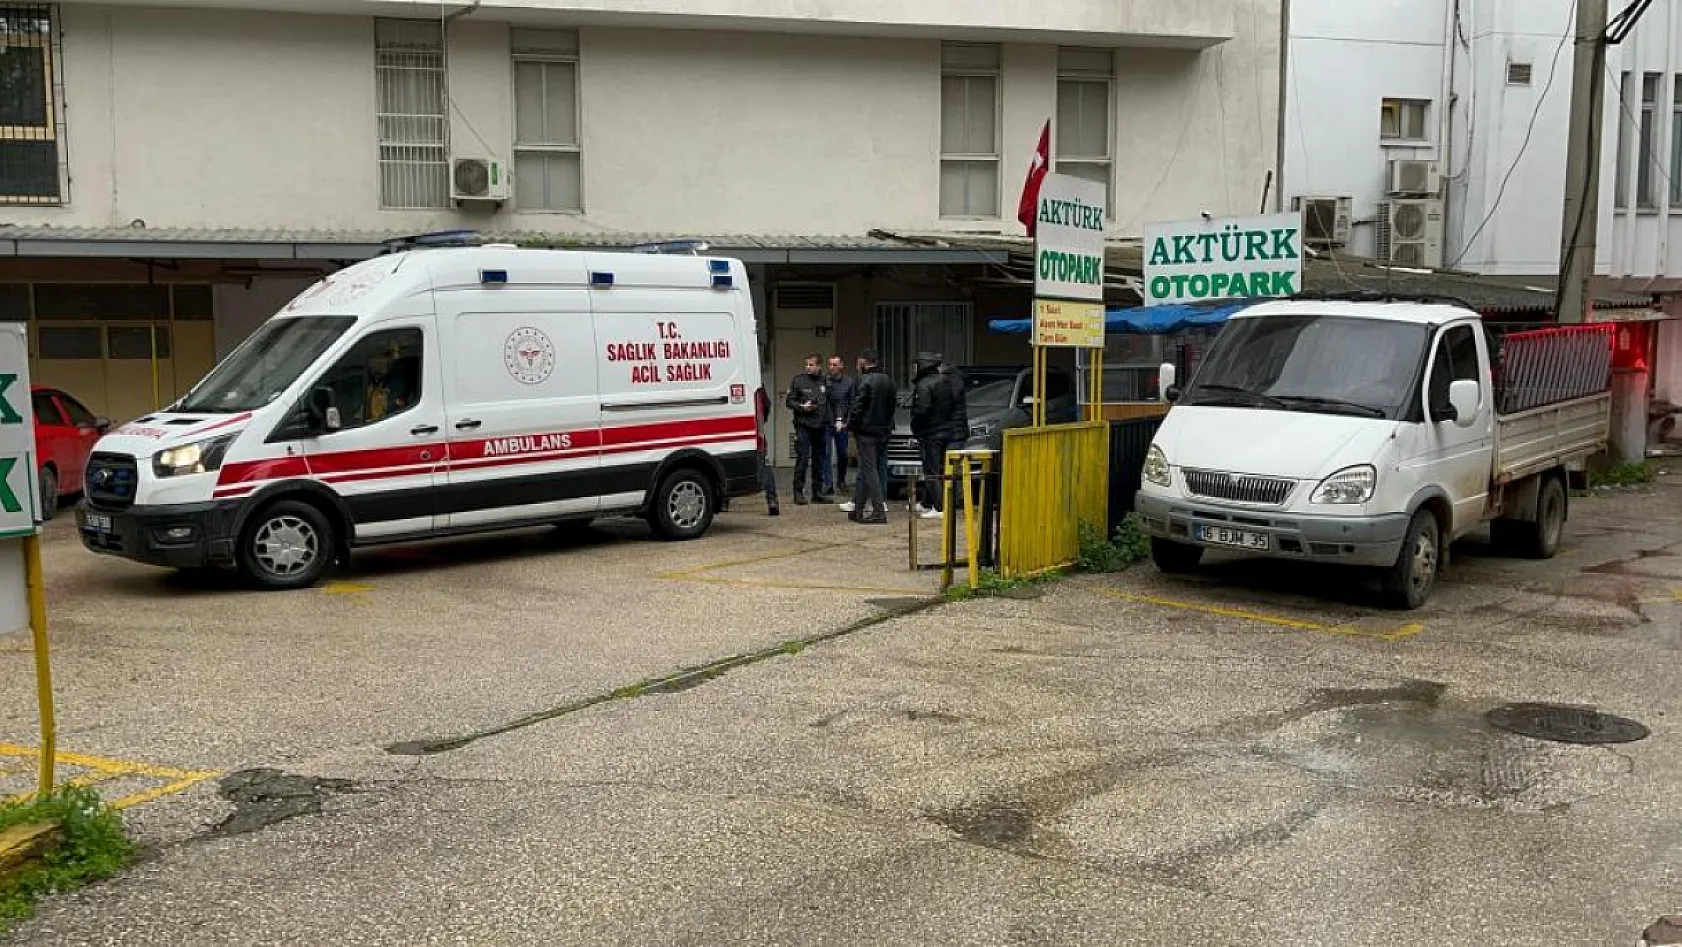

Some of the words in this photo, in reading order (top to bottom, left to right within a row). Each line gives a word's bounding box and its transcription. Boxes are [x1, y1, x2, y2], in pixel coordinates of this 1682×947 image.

[1039, 197, 1102, 232] AKTÜRK
[1148, 224, 1299, 265] AKTÜRK
[1040, 250, 1101, 285] OTOPARK
[1151, 271, 1296, 298] OTOPARK
[657, 322, 682, 339] T.C.
[607, 342, 657, 361] SAĞLIK
[664, 340, 731, 360] BAKANLIĞI
[632, 362, 662, 383] ACİL
[667, 362, 711, 381] SAĞLIK
[484, 434, 573, 456] AMBULANS
